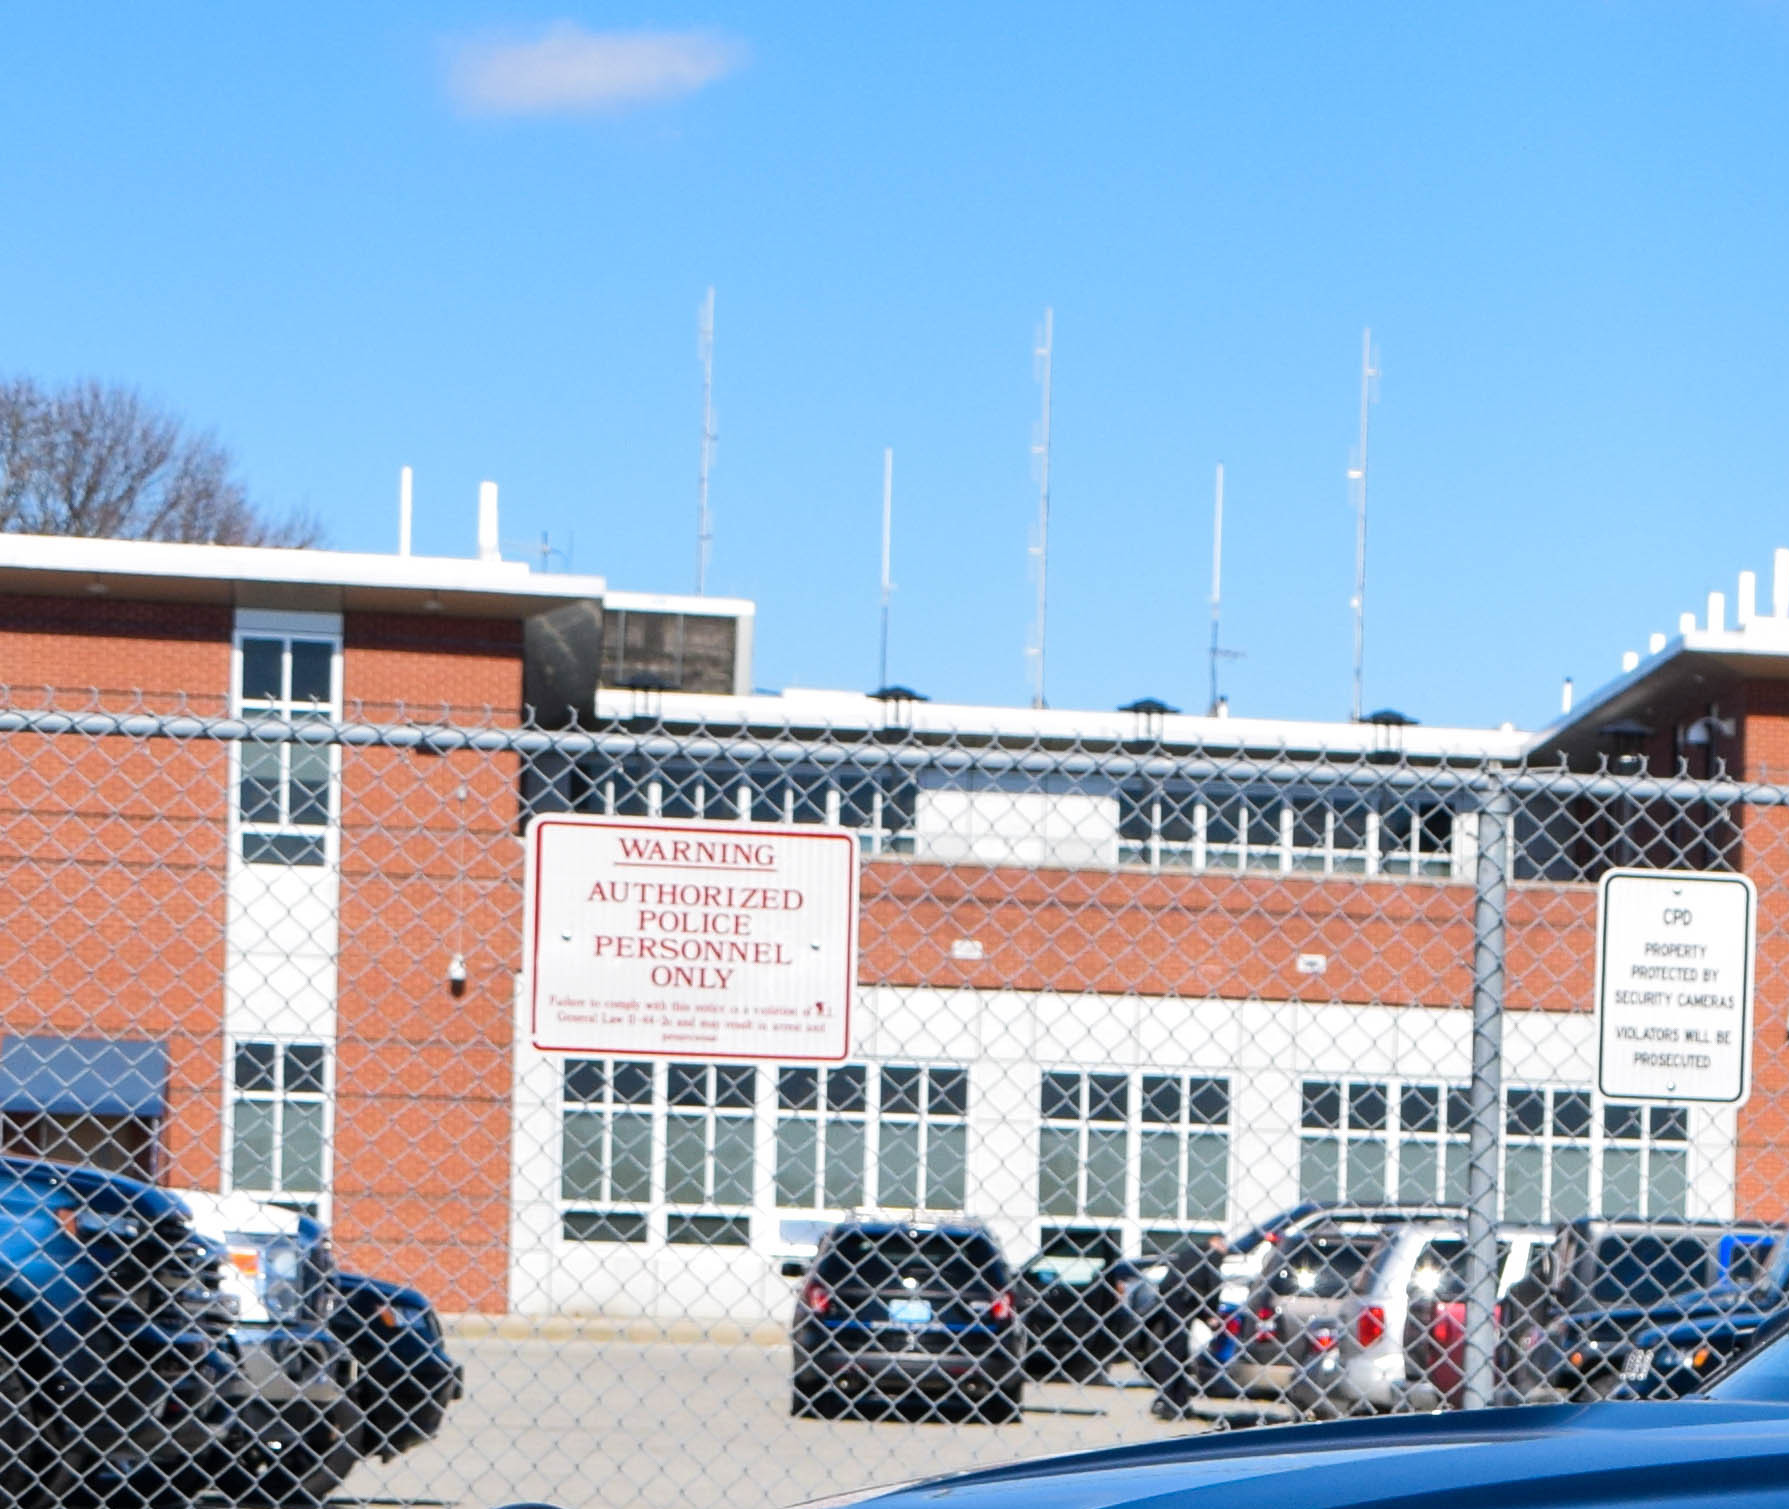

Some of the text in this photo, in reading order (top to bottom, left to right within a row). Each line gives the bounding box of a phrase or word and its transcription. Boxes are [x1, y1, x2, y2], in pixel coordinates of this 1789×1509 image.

[618, 837, 775, 866] WARNING
[588, 881, 804, 911] AUTHORIZED
[637, 910, 752, 936] POLICE
[1663, 908, 1693, 926] CPD
[594, 935, 793, 965] PERSONNEL
[1644, 942, 1708, 959] PROPERTY
[651, 966, 734, 990] ONLY
[1631, 964, 1720, 983] PROTECTED BY
[1615, 989, 1736, 1010] SECURITY CAMERAS
[1616, 1025, 1732, 1045] VIOLATORS WILL BE
[1633, 1052, 1711, 1069] PROSECUTED
